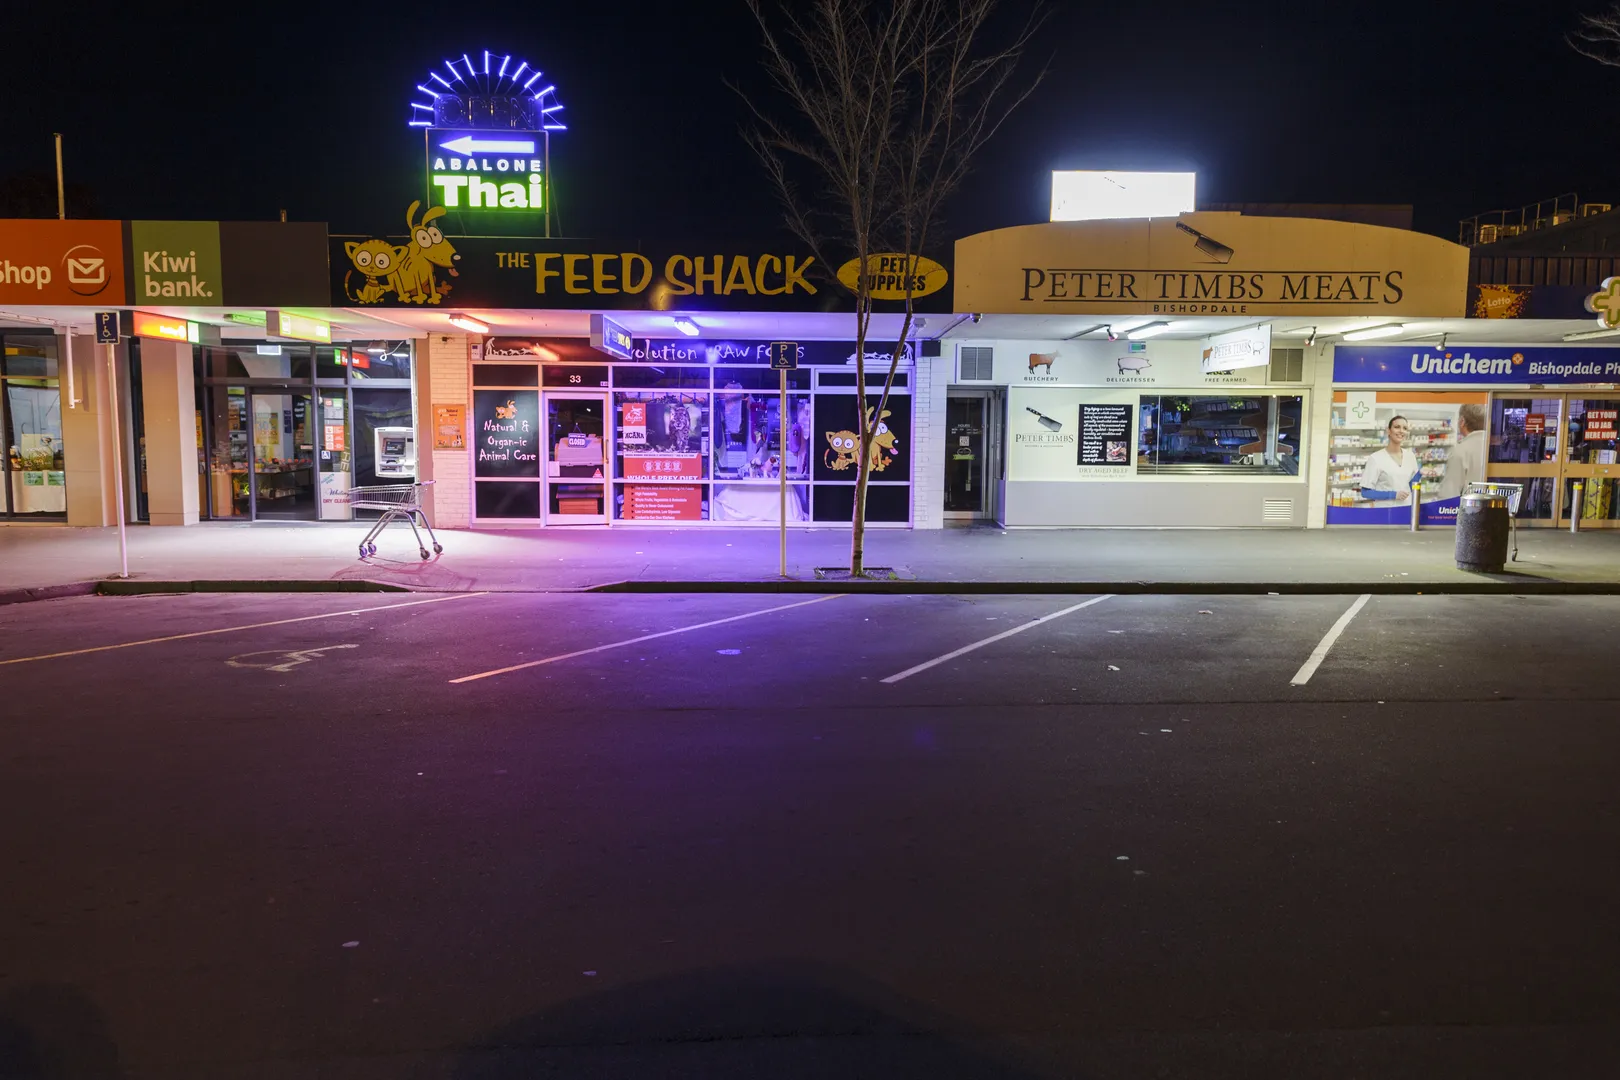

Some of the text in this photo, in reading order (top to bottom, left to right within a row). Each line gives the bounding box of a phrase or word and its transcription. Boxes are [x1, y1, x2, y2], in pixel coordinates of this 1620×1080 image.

[434, 158, 541, 172] ABALONE
[433, 174, 542, 209] Thai
[143, 251, 196, 273] Kiwi
[880, 257, 906, 273] PET
[495, 252, 818, 296] THE FEED SHACK
[145, 275, 213, 298] bank.
[1020, 268, 1403, 305] PETER TIMBS MEATS
[1153, 304, 1247, 313] BISHOPDALE
[1487, 297, 1511, 307] Lotto
[102, 314, 110, 325] P
[632, 339, 805, 361] olution RAW FOS
[780, 344, 788, 354] P
[1411, 353, 1620, 377] Unichem Bishopdale Ph
[569, 375, 581, 383] 33
[1587, 411, 1617, 419] GET YOUR
[484, 419, 529, 432] Natural &
[1588, 421, 1612, 429] FLU JAB
[1015, 434, 1074, 443] PETER TIMBS
[1584, 431, 1618, 439] HERE NOW
[487, 436, 527, 449] Organ-ic
[569, 438, 586, 446] CLOSED
[479, 448, 537, 461] Animal Care
[1438, 506, 1460, 514] Unich
